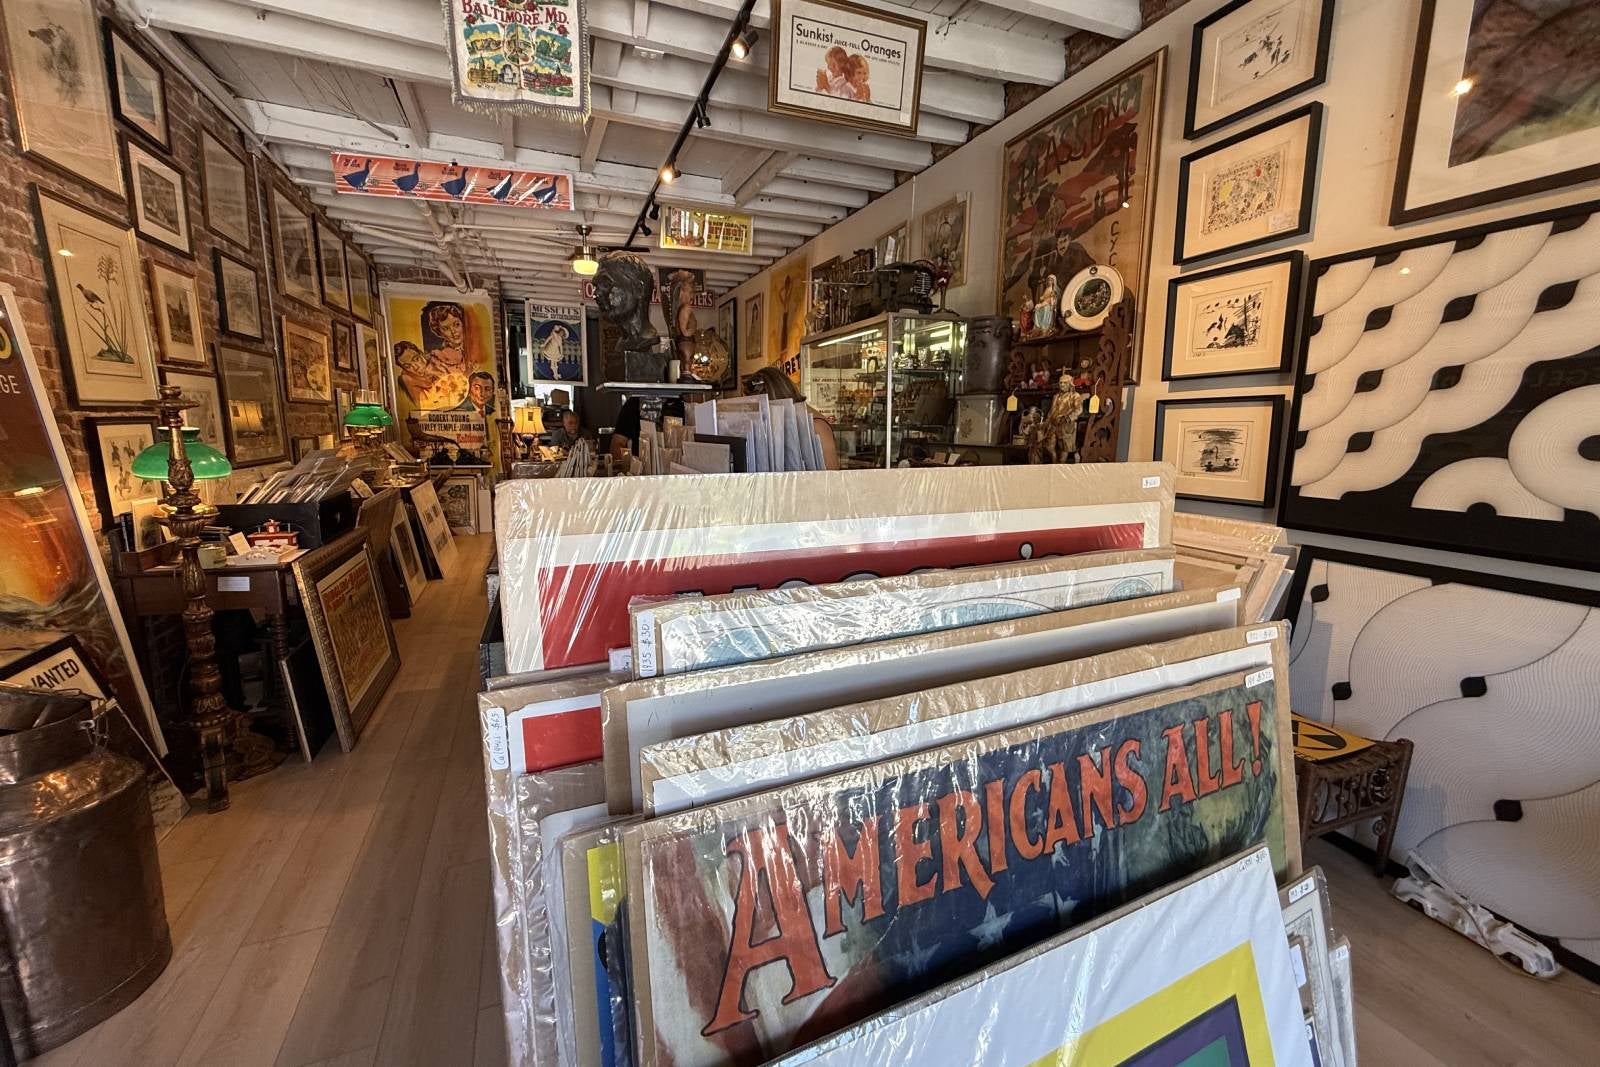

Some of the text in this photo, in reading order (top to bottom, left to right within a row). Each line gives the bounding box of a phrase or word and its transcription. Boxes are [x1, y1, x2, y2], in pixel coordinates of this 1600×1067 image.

[545, 7, 569, 24] MD.
[796, 23, 833, 43] Sunkist
[861, 39, 901, 59] Oranges
[700, 700, 1263, 1038] AMERICANS ALL!
